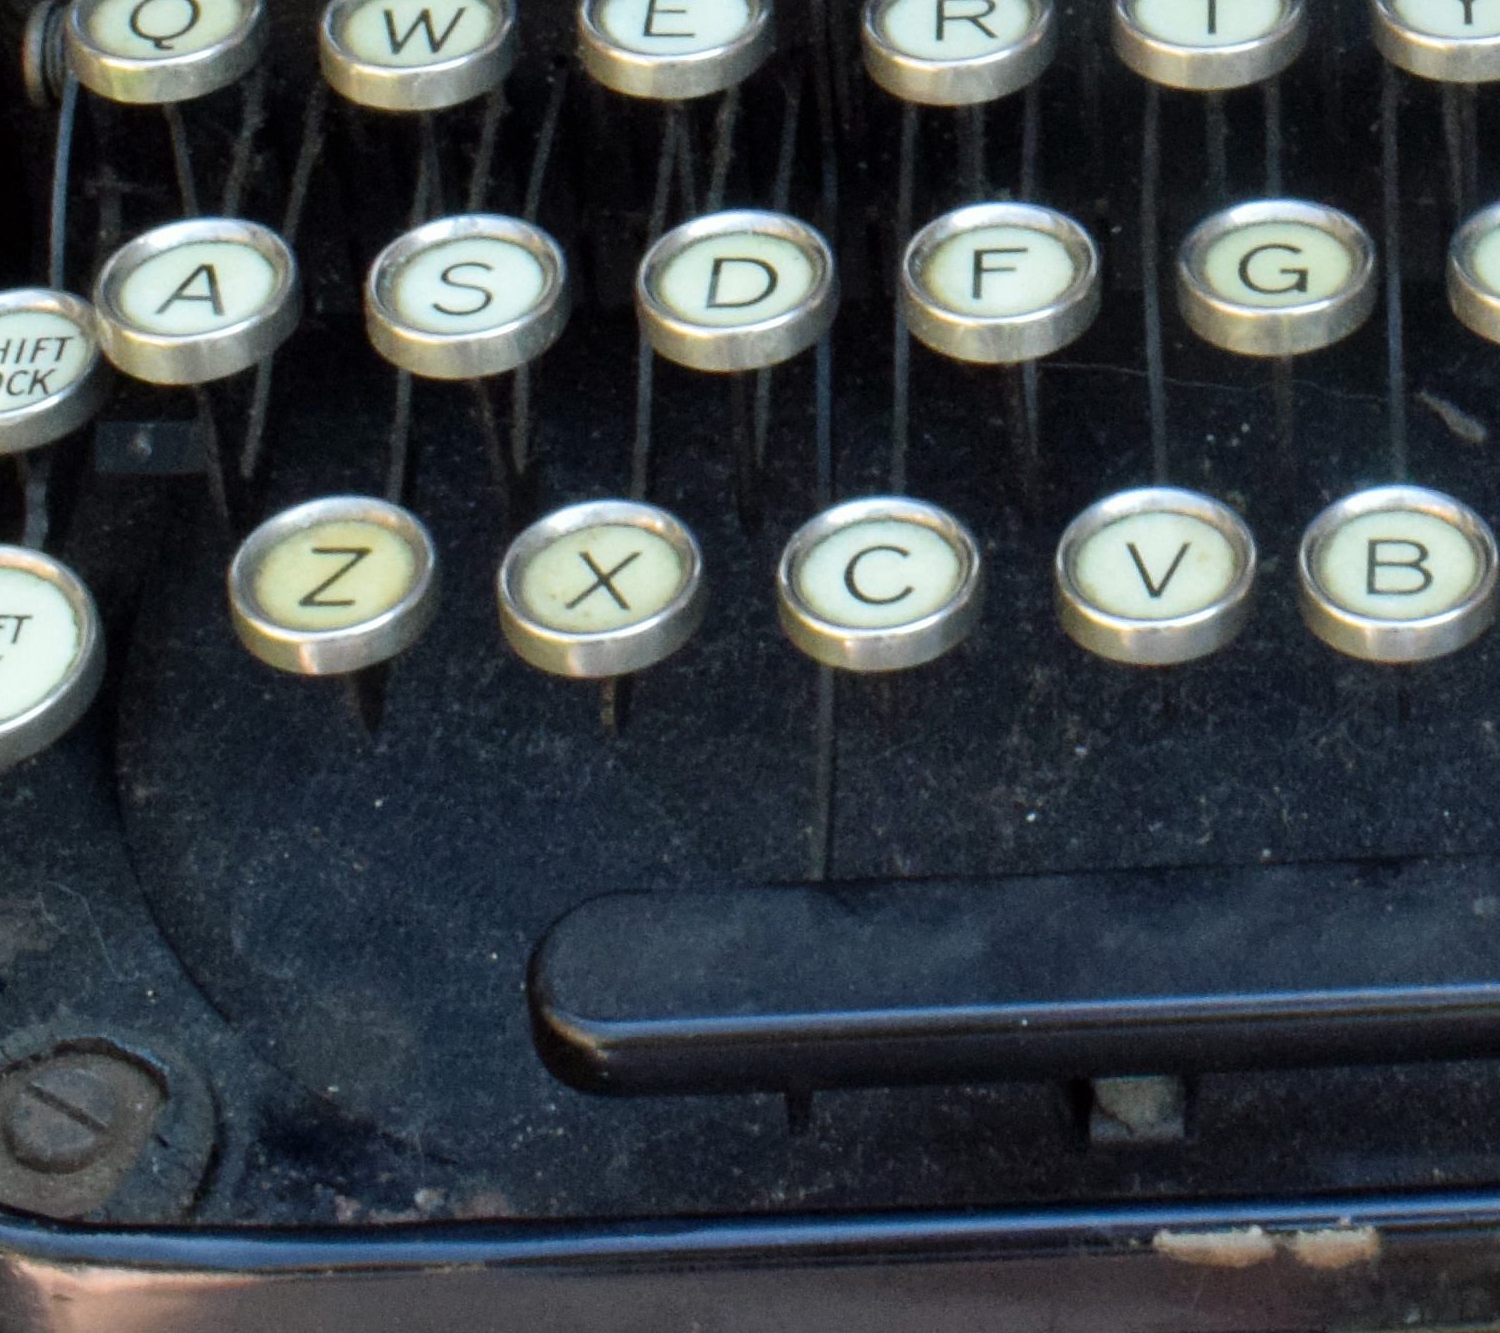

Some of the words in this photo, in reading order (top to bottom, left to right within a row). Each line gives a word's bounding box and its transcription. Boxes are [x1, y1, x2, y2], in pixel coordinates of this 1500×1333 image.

[384, 6, 466, 55] W
[156, 263, 224, 317] A
[432, 261, 493, 316] S
[705, 257, 779, 309] D
[972, 247, 1029, 301] F
[1239, 243, 1309, 295] G
[299, 547, 373, 608] Z
[565, 550, 643, 612] X
[844, 545, 915, 606] C
[1126, 540, 1192, 598] V
[1366, 538, 1434, 597] B
